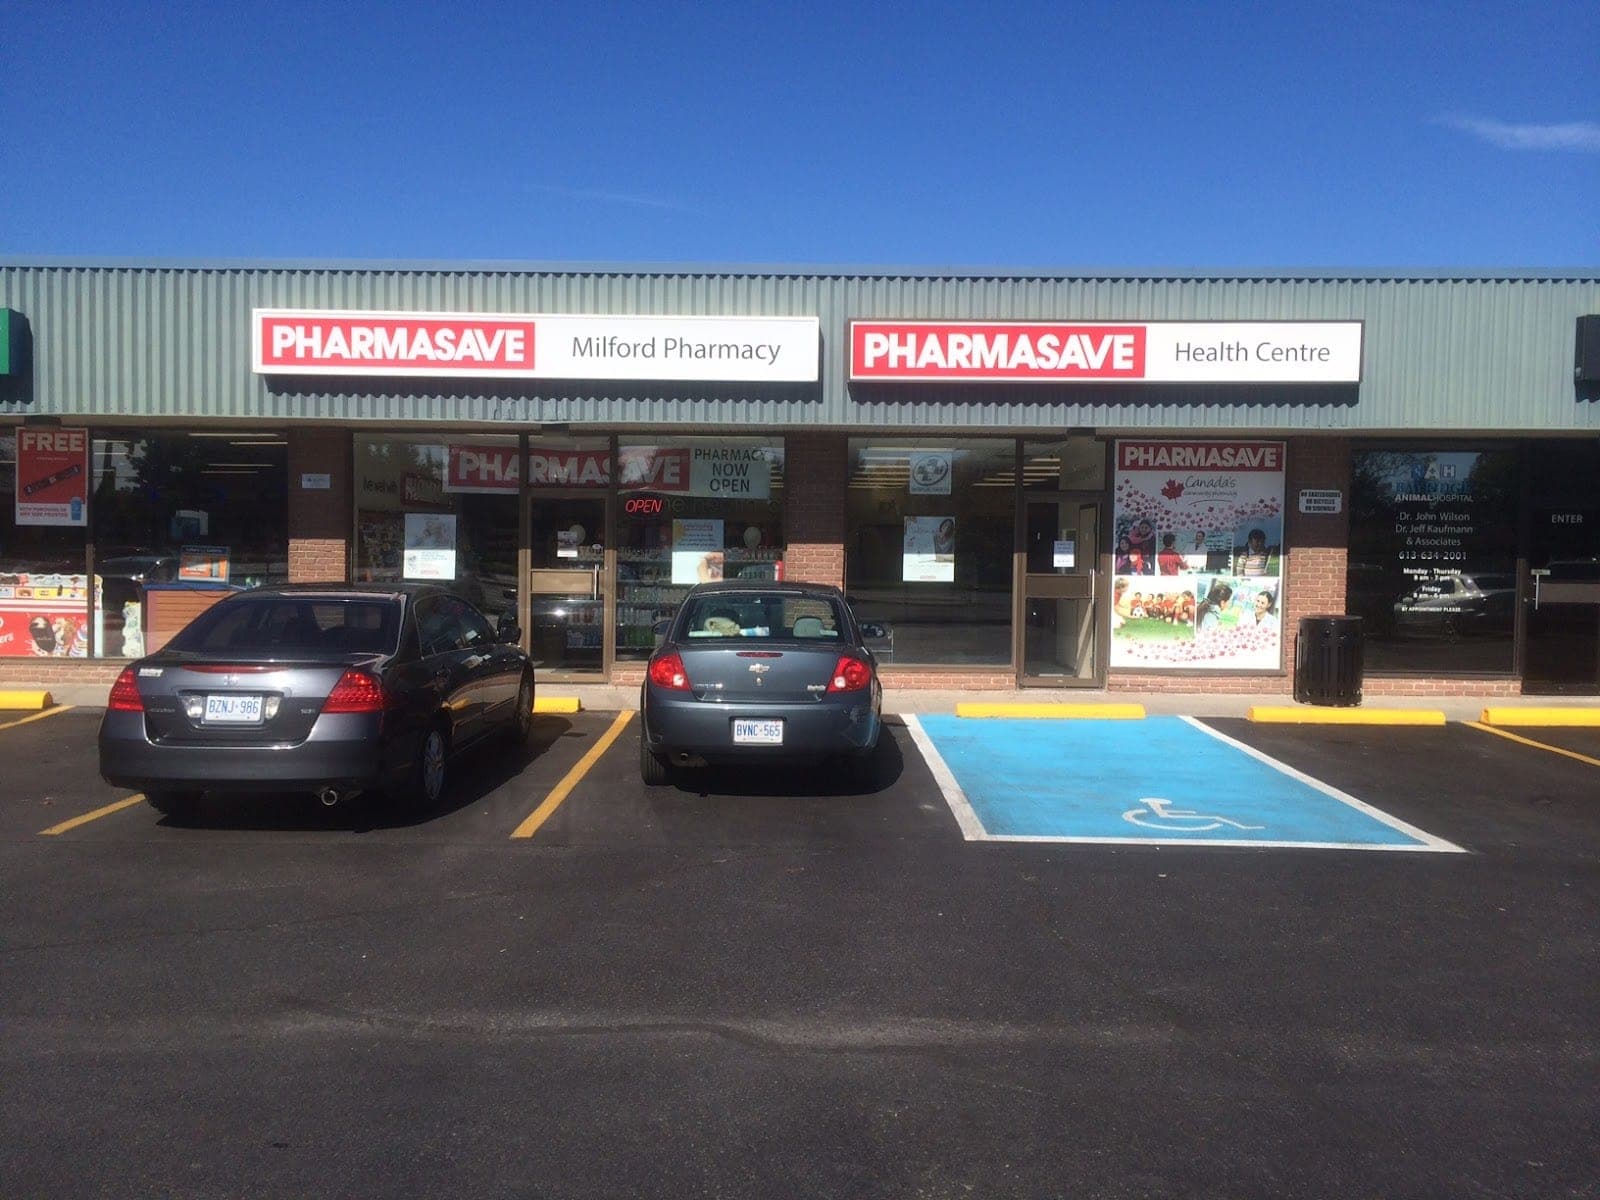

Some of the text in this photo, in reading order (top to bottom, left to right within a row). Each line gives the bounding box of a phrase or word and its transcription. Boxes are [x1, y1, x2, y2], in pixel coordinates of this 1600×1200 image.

[272, 325, 525, 362] PHARMASAVE
[572, 336, 781, 366] Milford Pharmacy
[863, 333, 1135, 370] PHARMASAVE
[1175, 342, 1331, 362] Health Centre
[22, 432, 84, 451] FREE
[1124, 447, 1277, 468] PHARMASAVE
[712, 463, 749, 477] NOW
[709, 479, 750, 492] OPEN
[1184, 475, 1237, 489] Canada's
[625, 500, 664, 513] OPEN
[1400, 511, 1471, 521] Dr. John Wilson
[1551, 514, 1584, 524] ENTER
[1395, 524, 1474, 534] Dr. Jeff Kaufmann
[1406, 536, 1461, 546] & Associates
[1398, 550, 1467, 560] 613-634-2001
[1433, 567, 1462, 576] Thursday
